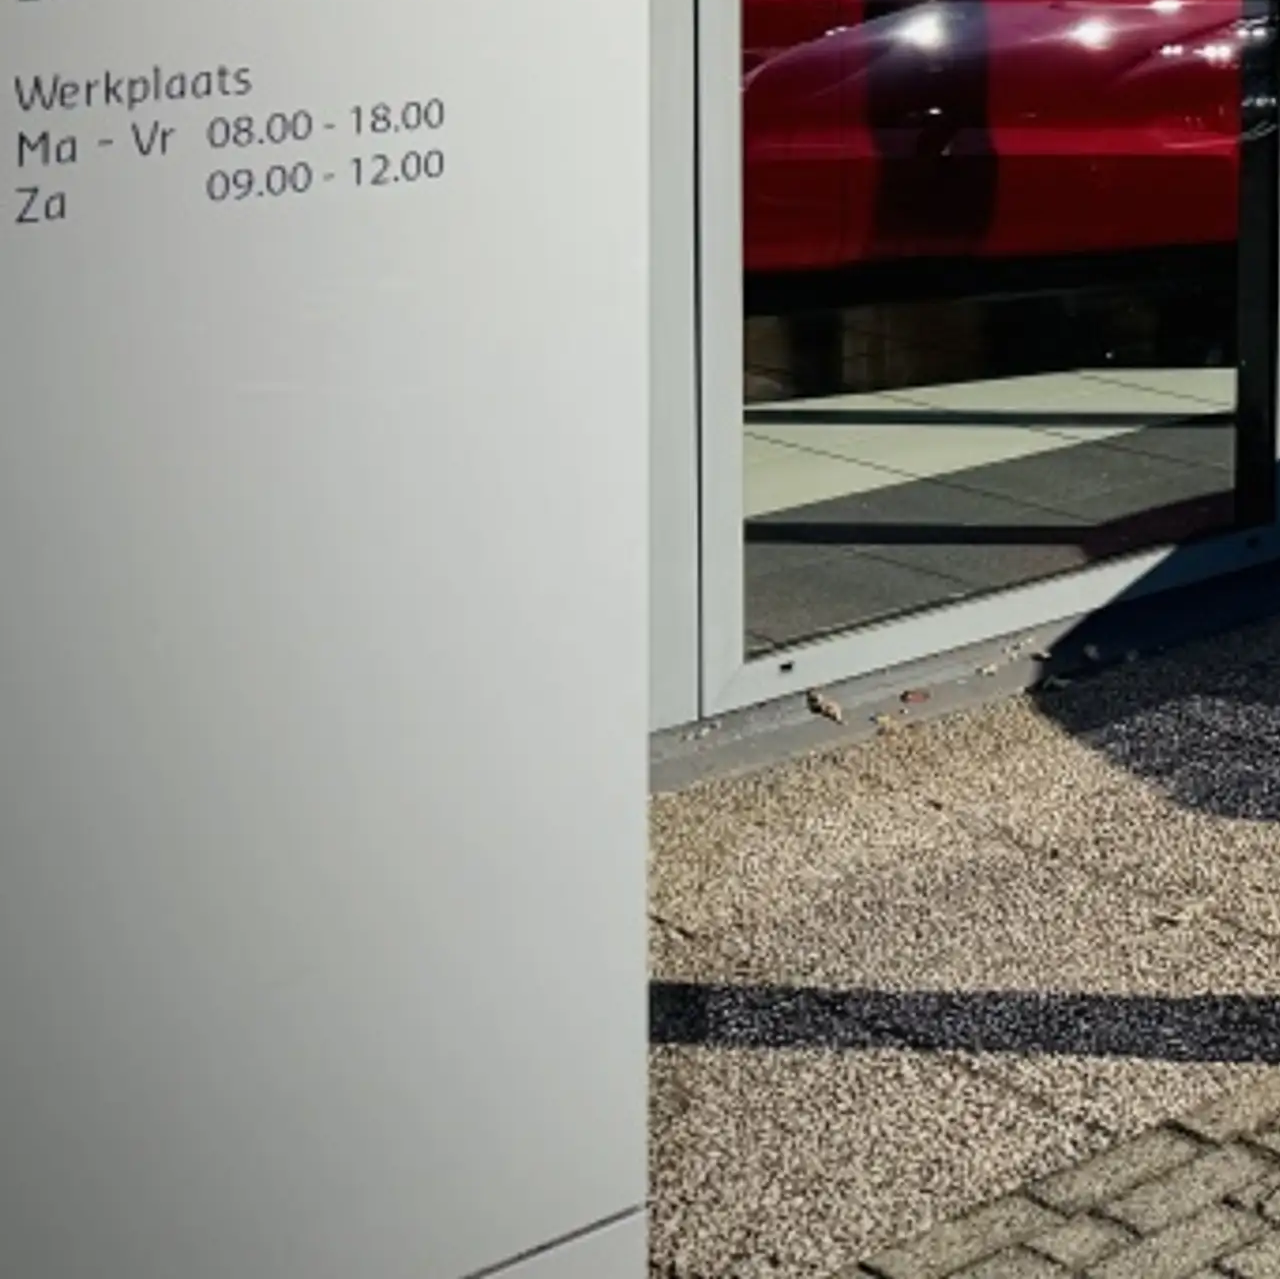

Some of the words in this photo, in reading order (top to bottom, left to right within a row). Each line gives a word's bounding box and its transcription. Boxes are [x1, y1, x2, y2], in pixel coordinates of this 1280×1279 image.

[14, 64, 254, 112] Werkplaats
[17, 130, 78, 168] Ma
[130, 119, 177, 157] Vr
[205, 108, 314, 150] 08.00
[350, 97, 445, 136] 18.00
[15, 185, 67, 225] Za
[205, 160, 314, 202] 09.00
[350, 148, 445, 187] 12.00
